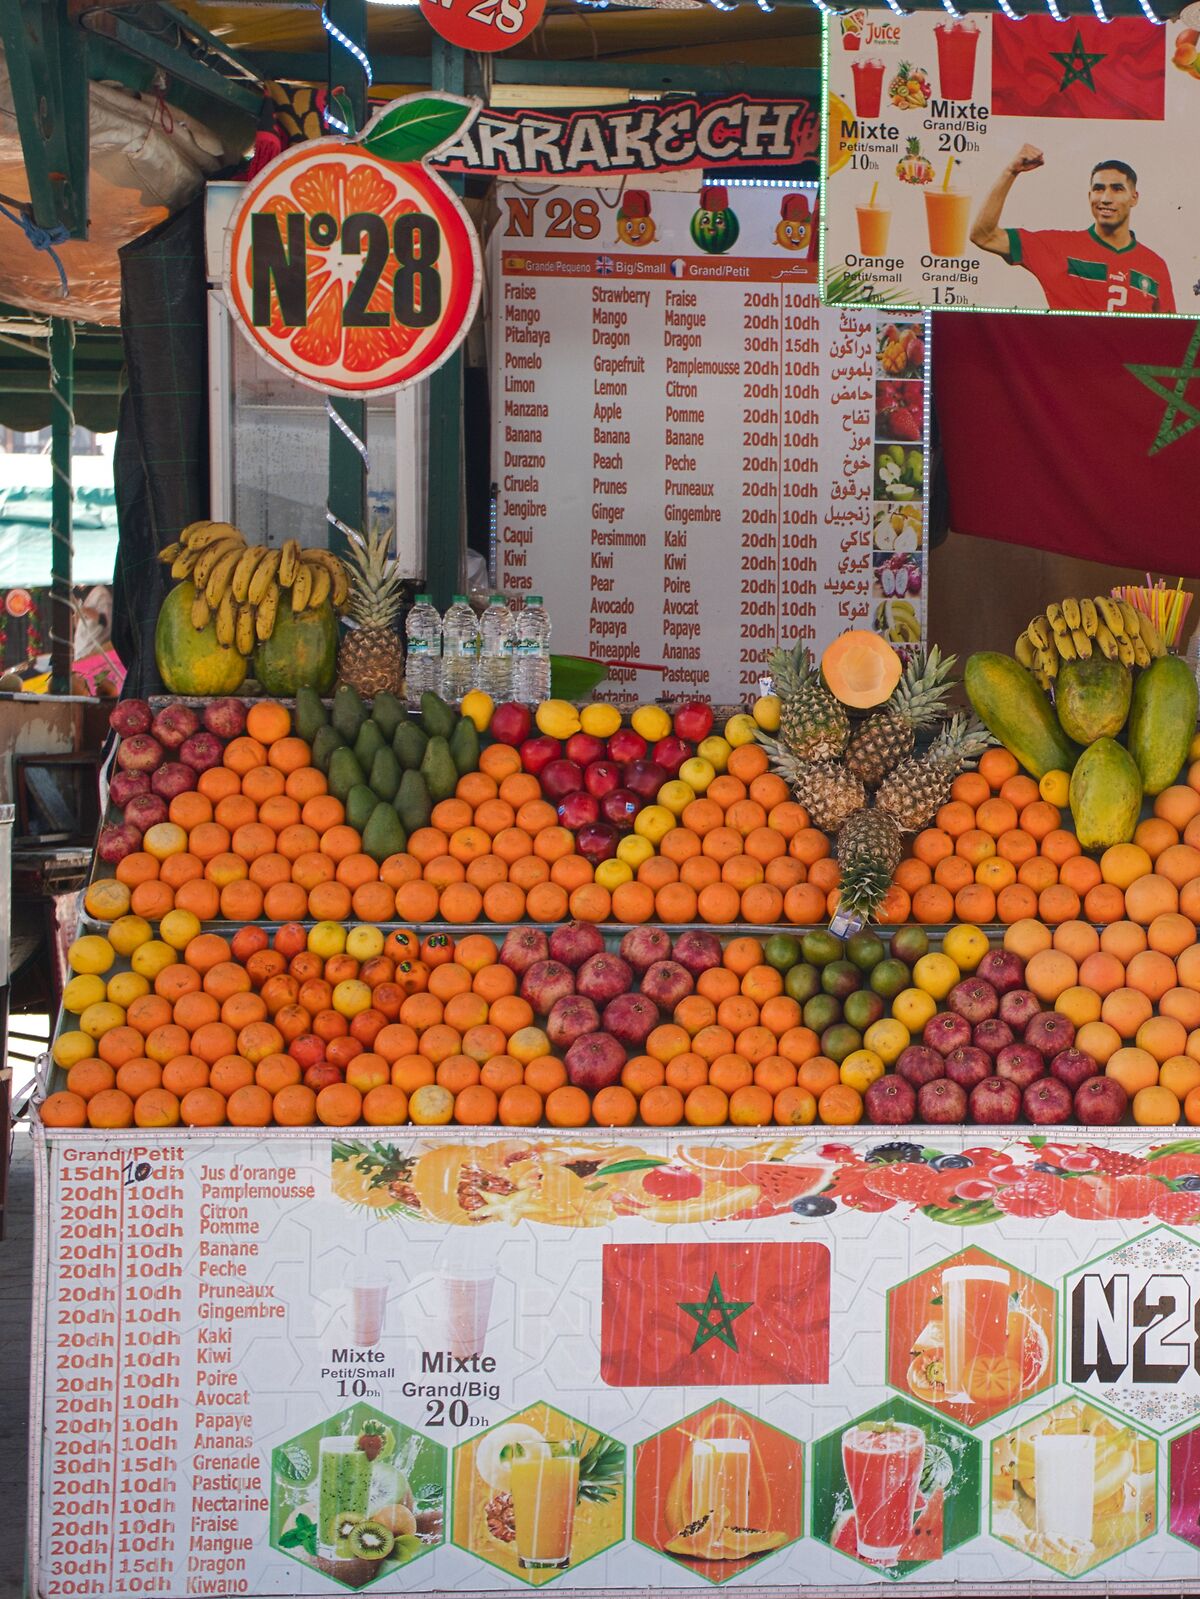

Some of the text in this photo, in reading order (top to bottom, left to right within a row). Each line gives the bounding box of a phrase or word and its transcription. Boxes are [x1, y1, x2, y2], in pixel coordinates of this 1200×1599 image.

[866, 23, 900, 45] Juice
[931, 101, 989, 119] Mixte
[841, 121, 899, 139] Mixte
[923, 120, 987, 133] Grand/Big
[839, 142, 898, 152] Petit/small
[545, 198, 601, 240] 28
[251, 213, 441, 327] N°28
[525, 259, 750, 278] Grande/Pequeno Big/Small Grand/Petit
[845, 254, 980, 271] Orange Orange
[843, 272, 902, 282] Petit/small
[922, 272, 978, 284] Grand/Big
[504, 285, 819, 309] Fraise Strawberry Fraise 20dh 10dh
[505, 353, 819, 377] Pomelo Grapefruit Pamplemousse 20dh 10dh
[504, 402, 819, 425] Manzana Apple Pomme 20dh 10dh
[504, 502, 817, 525] Jengibre Ginger Gingembre 20dh 10dh
[590, 599, 816, 616] Avocado Avocat 20dh 10dh
[60, 1166, 120, 1182] 15dh
[200, 1166, 226, 1181] Jus
[57, 1328, 232, 1348] 20dh 10dh Kaki
[332, 1349, 385, 1364] Mixte
[421, 1353, 496, 1374] Mixte
[321, 1367, 395, 1380] Petit/Small
[402, 1382, 500, 1400] Grand/Big
[53, 1455, 260, 1475] 30dh 15dh Grenade
[51, 1536, 253, 1555] 20dh 10dh Mangue
